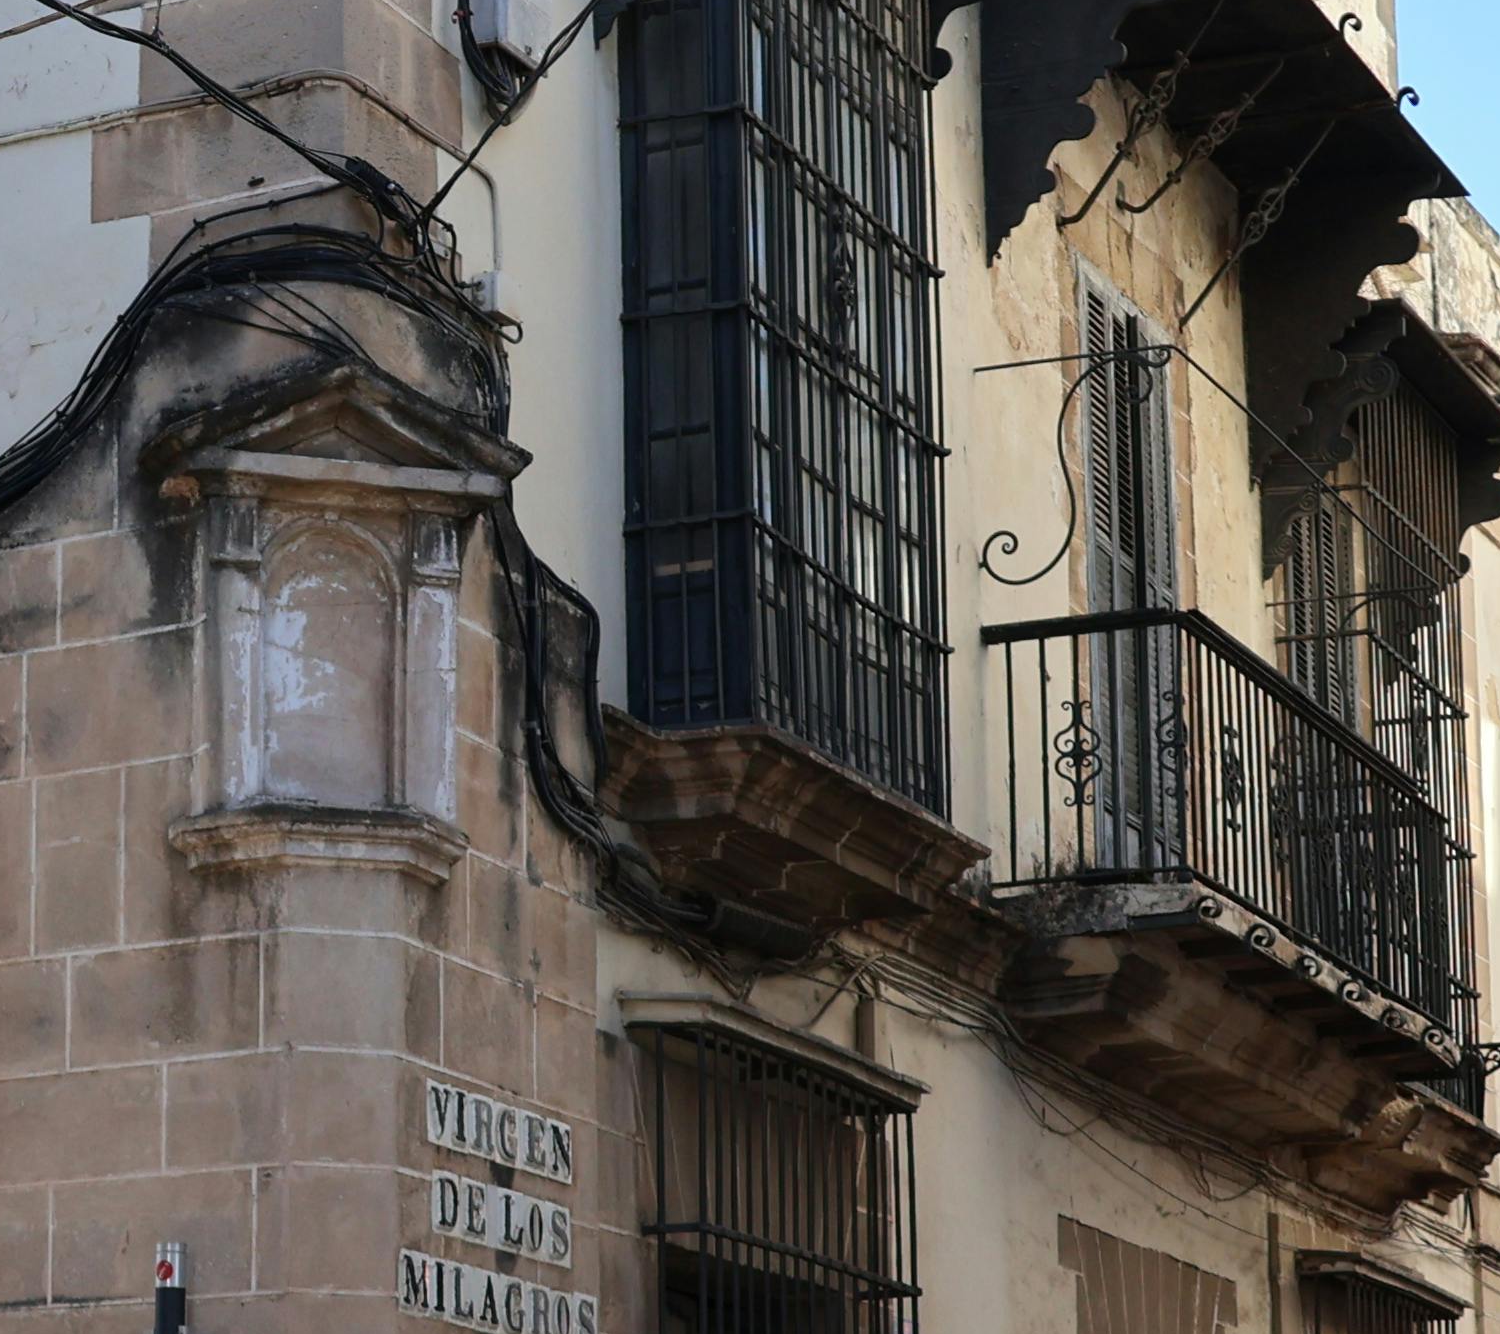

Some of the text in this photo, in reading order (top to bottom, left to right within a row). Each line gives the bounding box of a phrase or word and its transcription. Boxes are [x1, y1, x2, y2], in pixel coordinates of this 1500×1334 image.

[431, 1085, 571, 1176] VIRGEN
[437, 1177, 570, 1261] DE LOS
